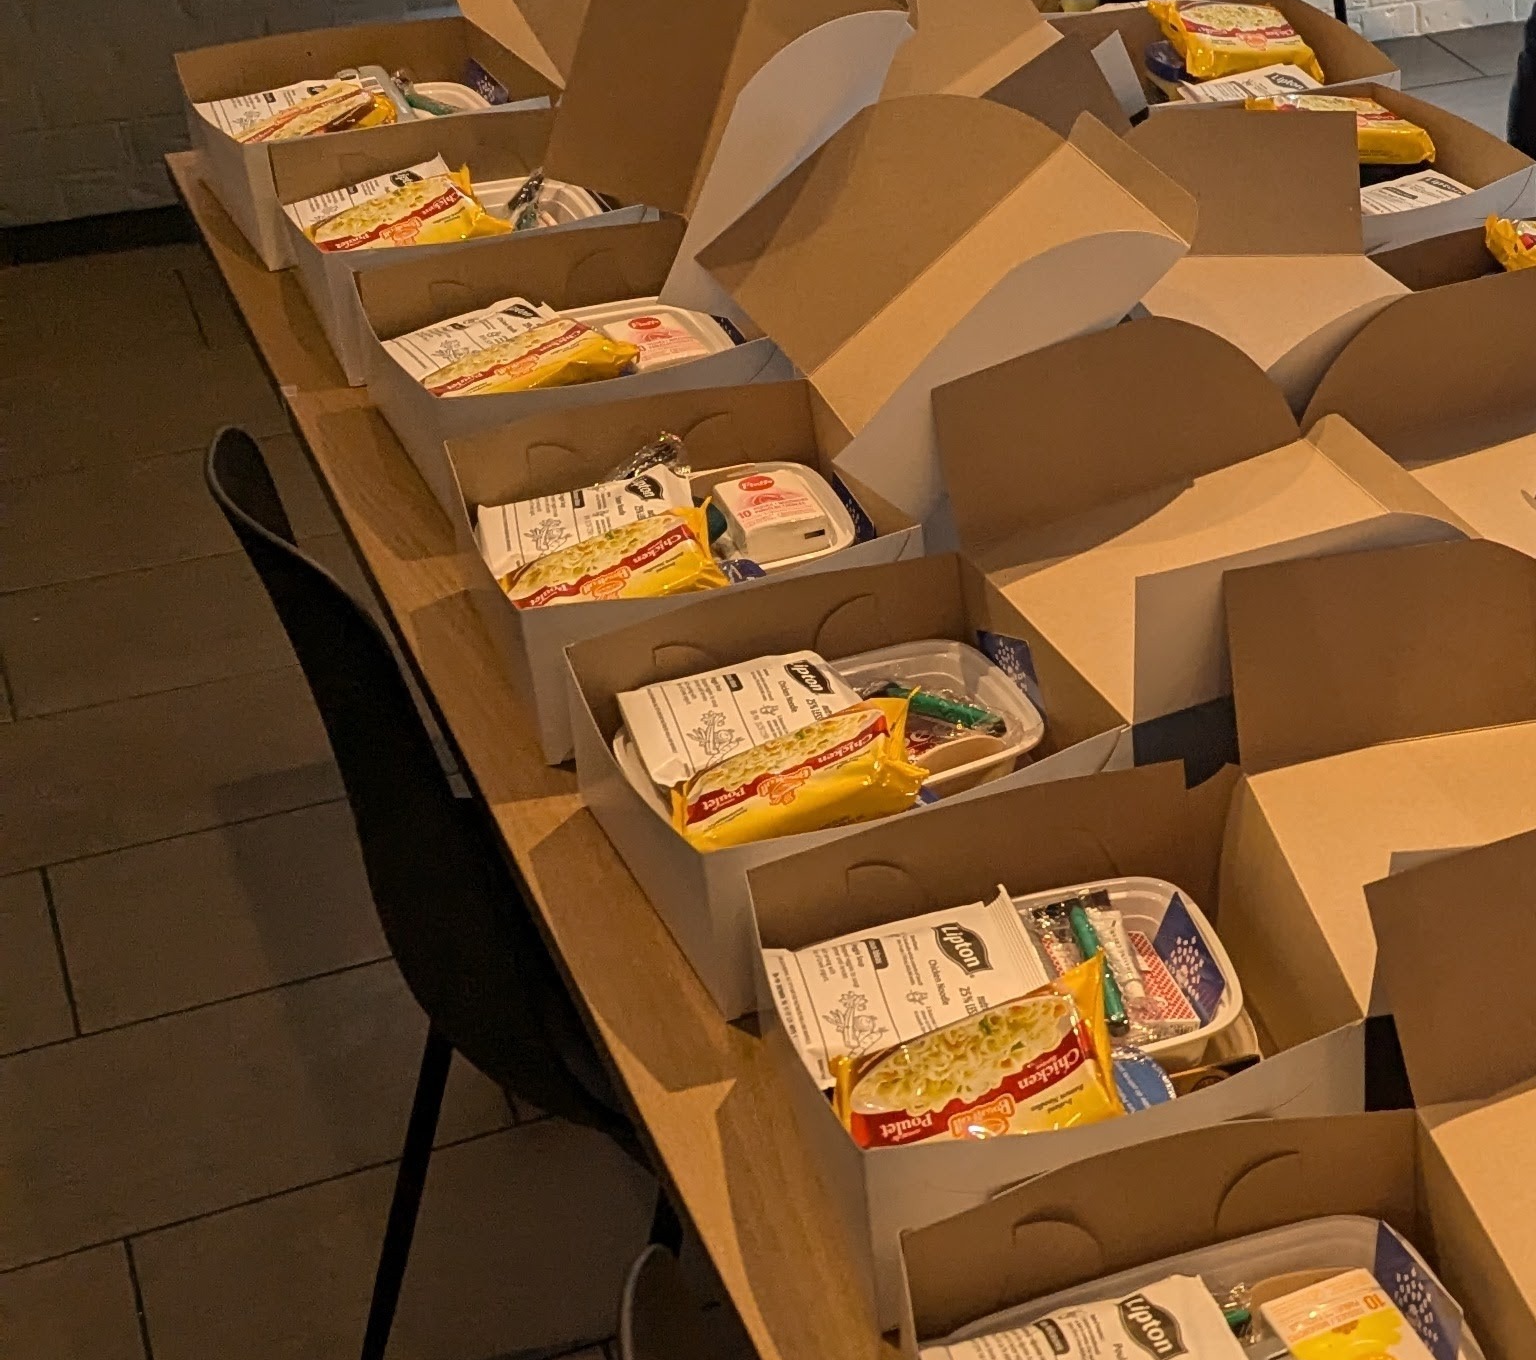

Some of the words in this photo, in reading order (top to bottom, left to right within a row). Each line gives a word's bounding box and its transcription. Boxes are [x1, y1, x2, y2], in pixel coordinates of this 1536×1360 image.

[632, 476, 655, 499] ipton
[738, 509, 752, 519] 10
[632, 533, 683, 564] Chicken
[817, 733, 873, 764] Chicken
[940, 925, 981, 969] Lipton
[927, 959, 943, 987] Chicken
[935, 983, 952, 1007] Noodle
[1017, 1047, 1081, 1091] Chicken
[879, 1115, 934, 1139] Poulet
[1363, 1293, 1385, 1310] 10
[1124, 1297, 1174, 1354] Lipton
